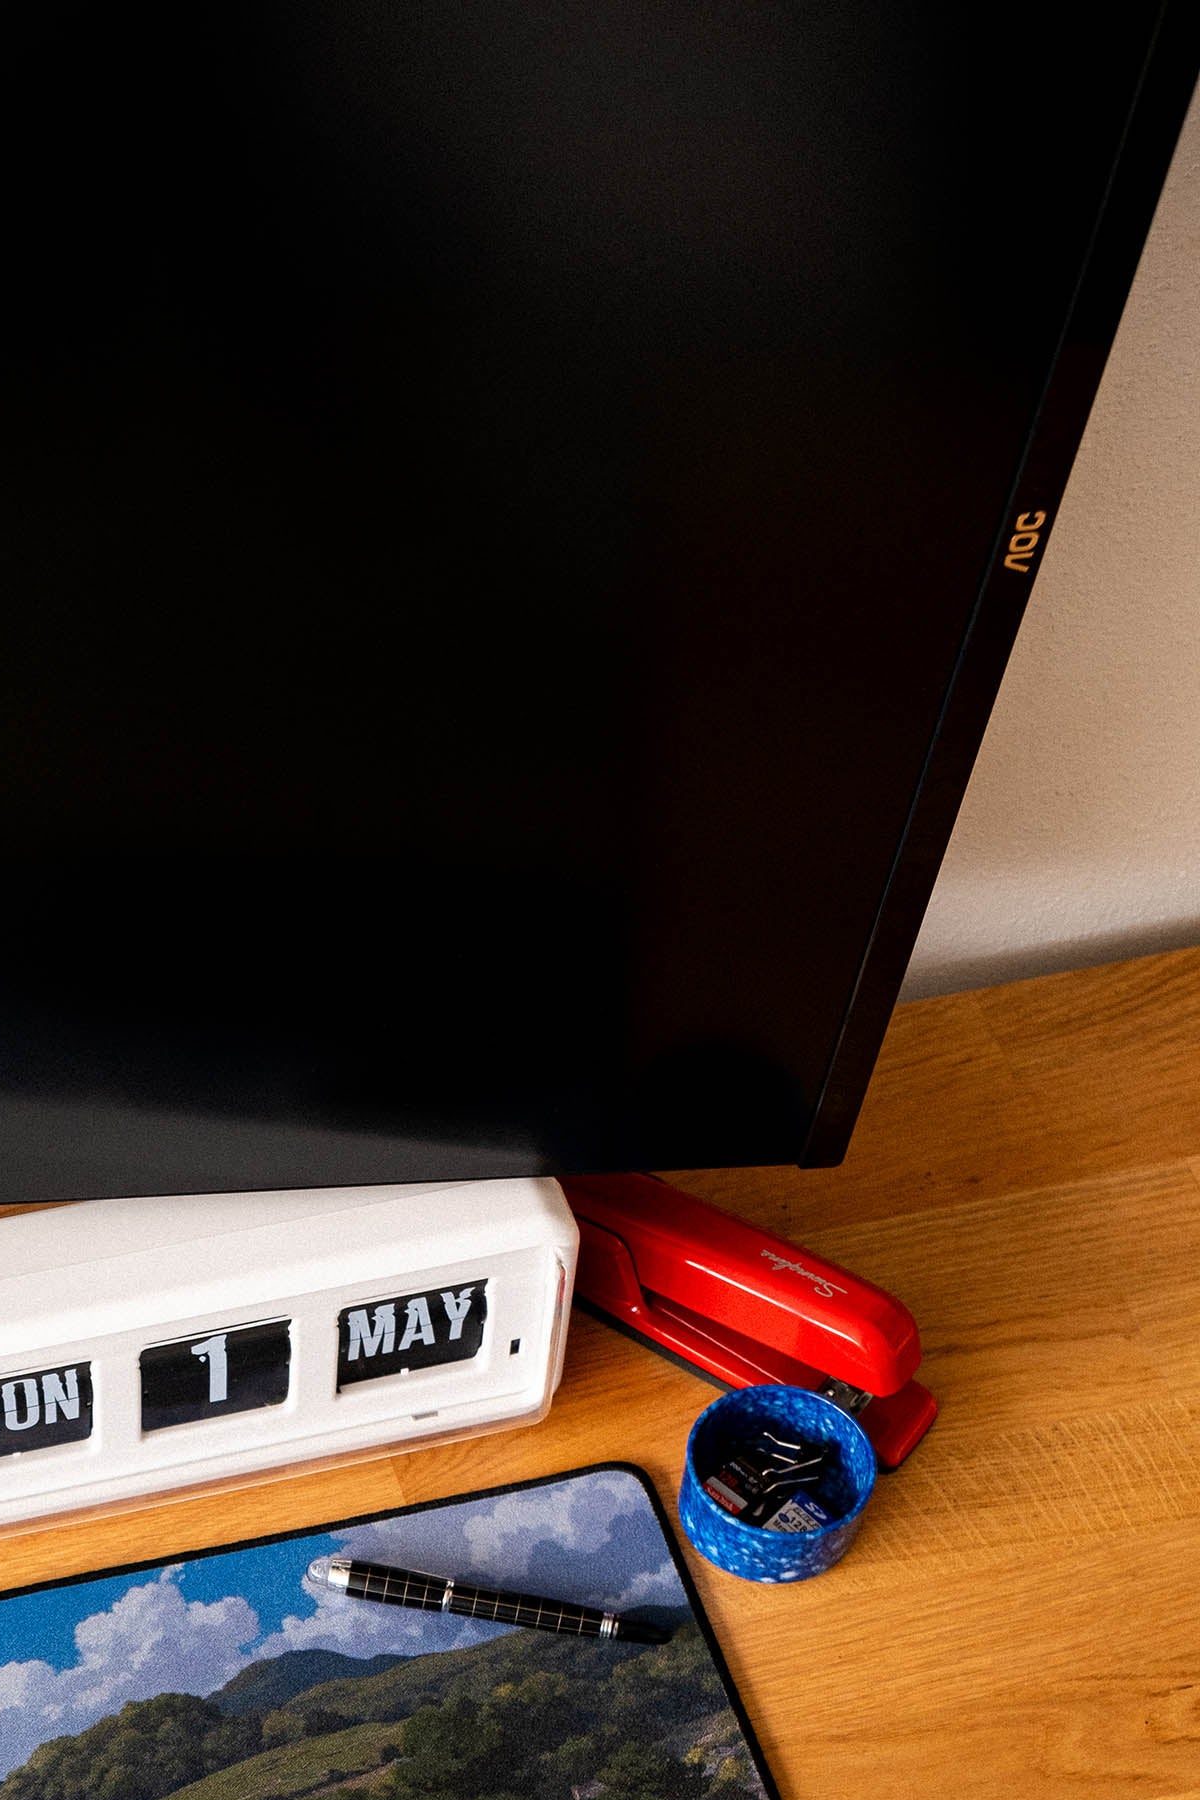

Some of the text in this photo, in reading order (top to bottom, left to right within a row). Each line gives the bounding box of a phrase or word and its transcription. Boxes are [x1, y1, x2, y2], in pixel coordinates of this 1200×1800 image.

[1004, 510, 1047, 573] AOC
[347, 1286, 475, 1361] MAY
[191, 1333, 229, 1403] 1
